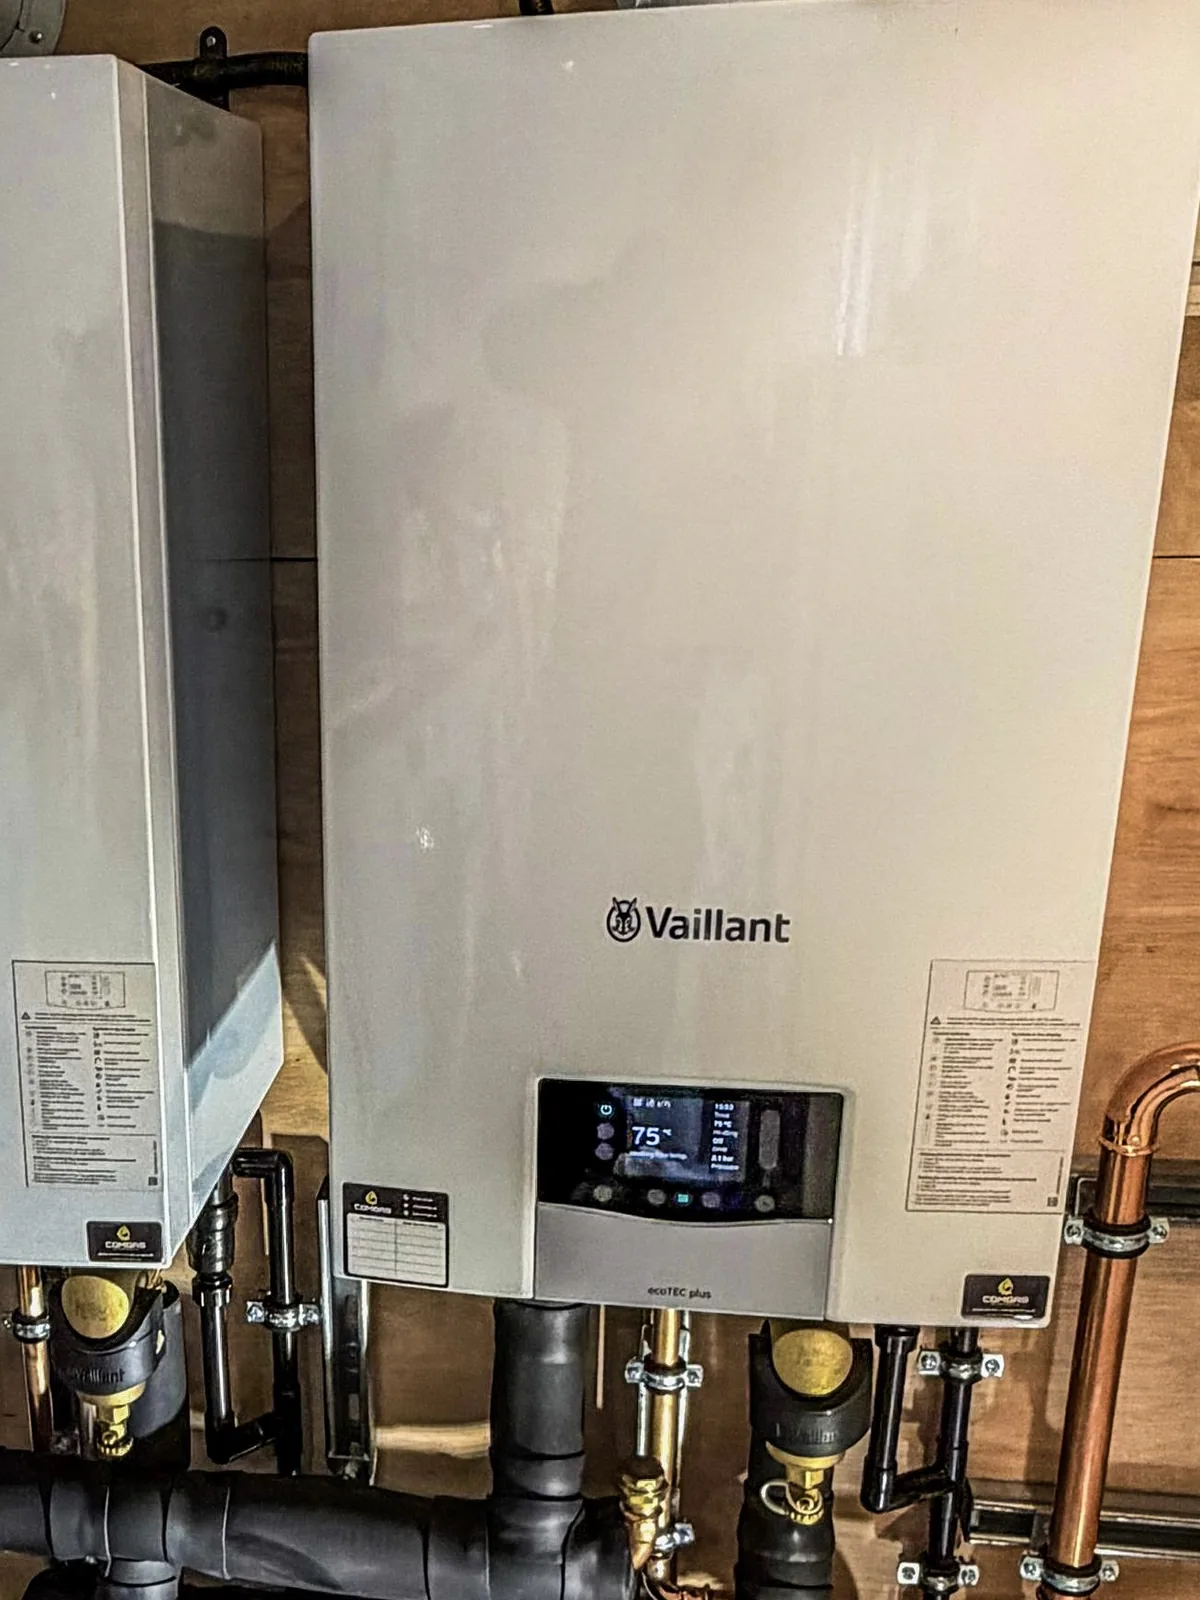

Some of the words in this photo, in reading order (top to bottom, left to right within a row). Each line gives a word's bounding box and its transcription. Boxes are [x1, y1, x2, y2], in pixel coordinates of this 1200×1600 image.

[645, 906, 791, 943] Vaillant
[647, 1287, 686, 1297] ecoTEC
[689, 1288, 712, 1299] plus
